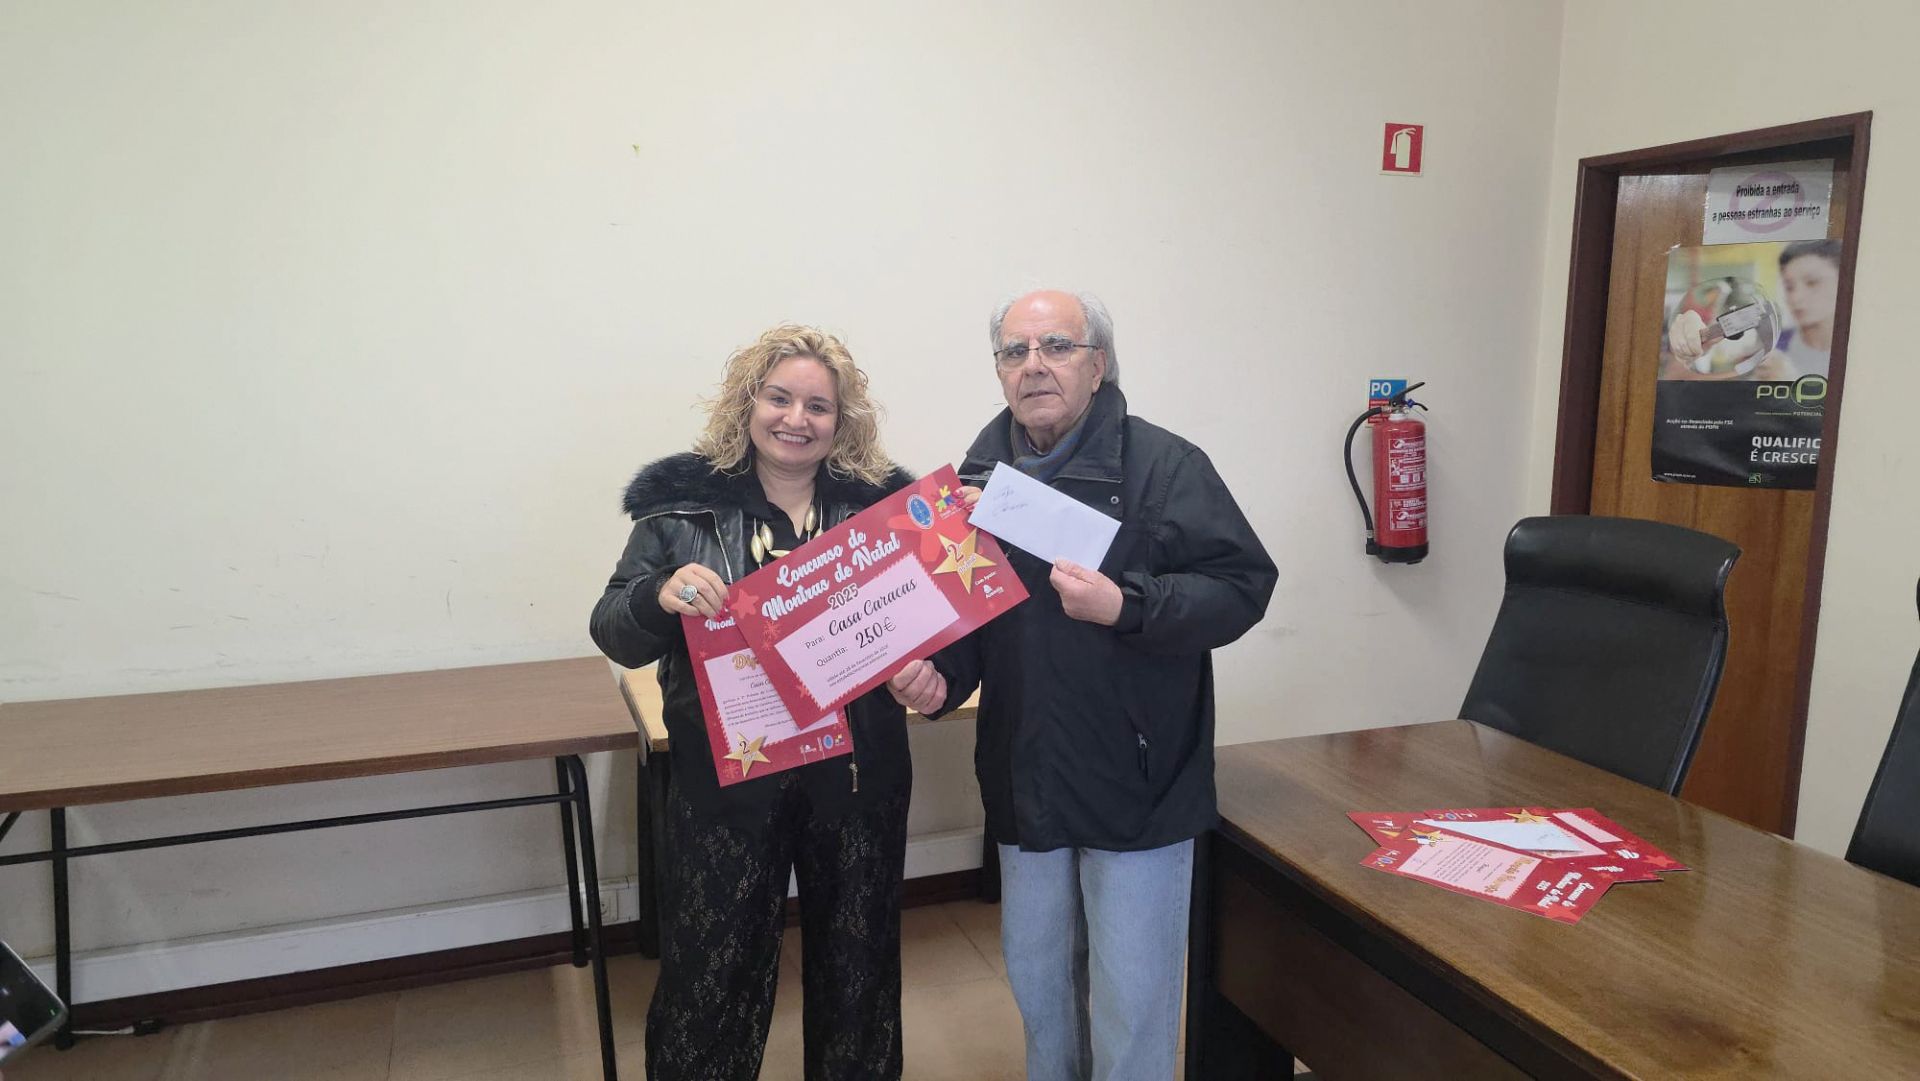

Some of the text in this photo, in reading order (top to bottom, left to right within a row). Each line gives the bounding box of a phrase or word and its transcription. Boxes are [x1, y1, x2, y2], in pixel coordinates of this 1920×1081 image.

[1736, 182, 1800, 197] Proibida a entrada
[1712, 204, 1821, 224] a pessoas estranhas ao serviço
[1752, 436, 1822, 449] QUALIFIC
[1750, 448, 1818, 465] É CRESCE
[776, 528, 866, 587] Concurso de
[761, 532, 900, 621] Montras de Natal
[828, 583, 859, 610] 2025
[805, 579, 918, 650] Para: Casa Caracas
[816, 616, 897, 668] Quantia: 250€
